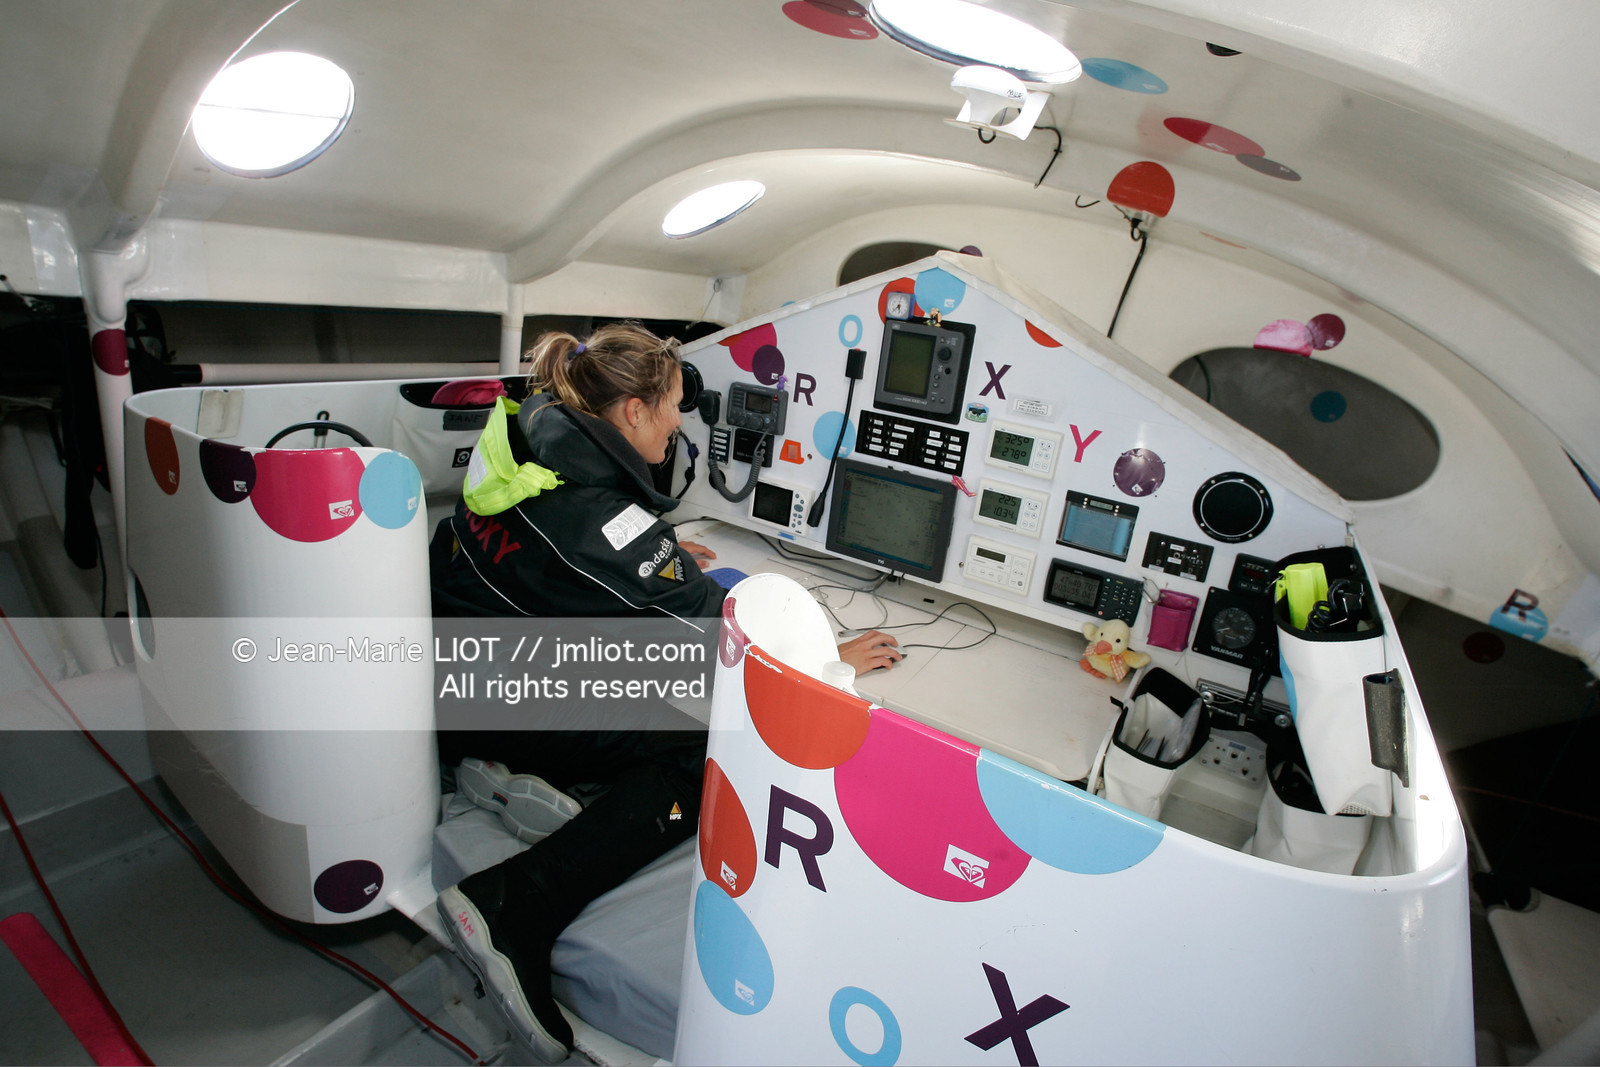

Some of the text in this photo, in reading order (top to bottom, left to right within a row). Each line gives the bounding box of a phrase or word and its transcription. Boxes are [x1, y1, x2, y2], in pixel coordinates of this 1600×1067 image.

[979, 361, 1012, 400] X
[1069, 423, 1102, 463] Y
[464, 507, 522, 564] OXY
[1210, 645, 1244, 659] YANMAR
[764, 784, 835, 893] R
[457, 911, 476, 938] SAM
